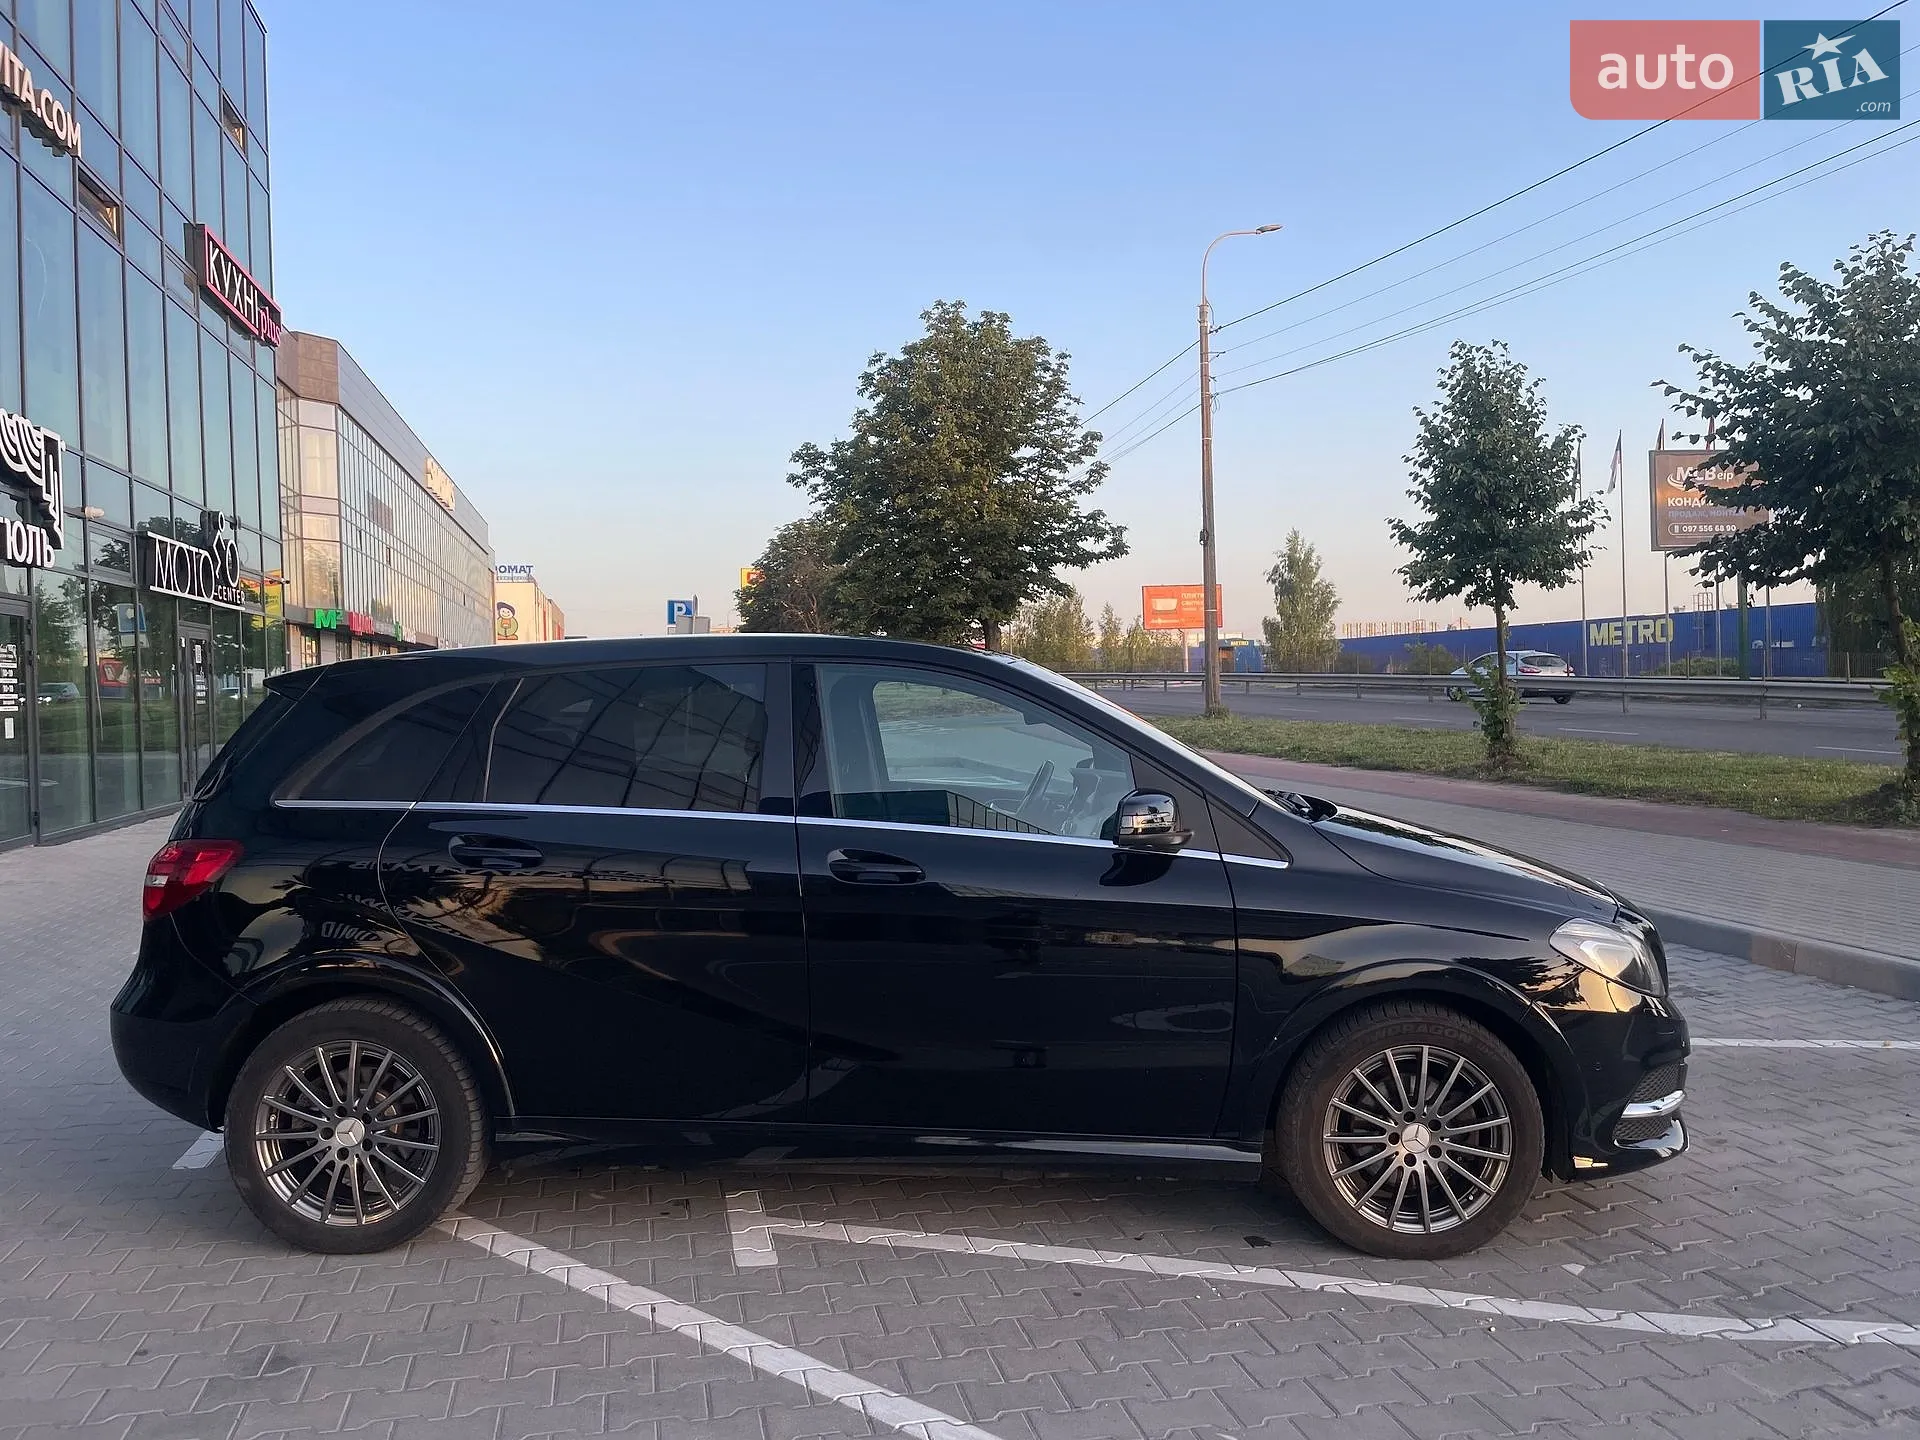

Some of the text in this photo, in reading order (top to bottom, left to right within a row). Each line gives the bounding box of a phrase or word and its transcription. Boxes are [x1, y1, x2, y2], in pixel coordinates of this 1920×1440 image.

[0, 40, 82, 158] ITA.COM
[259, 306, 281, 347] plus
[495, 564, 534, 574] ОМАТ
[1590, 618, 1674, 647] METRO
